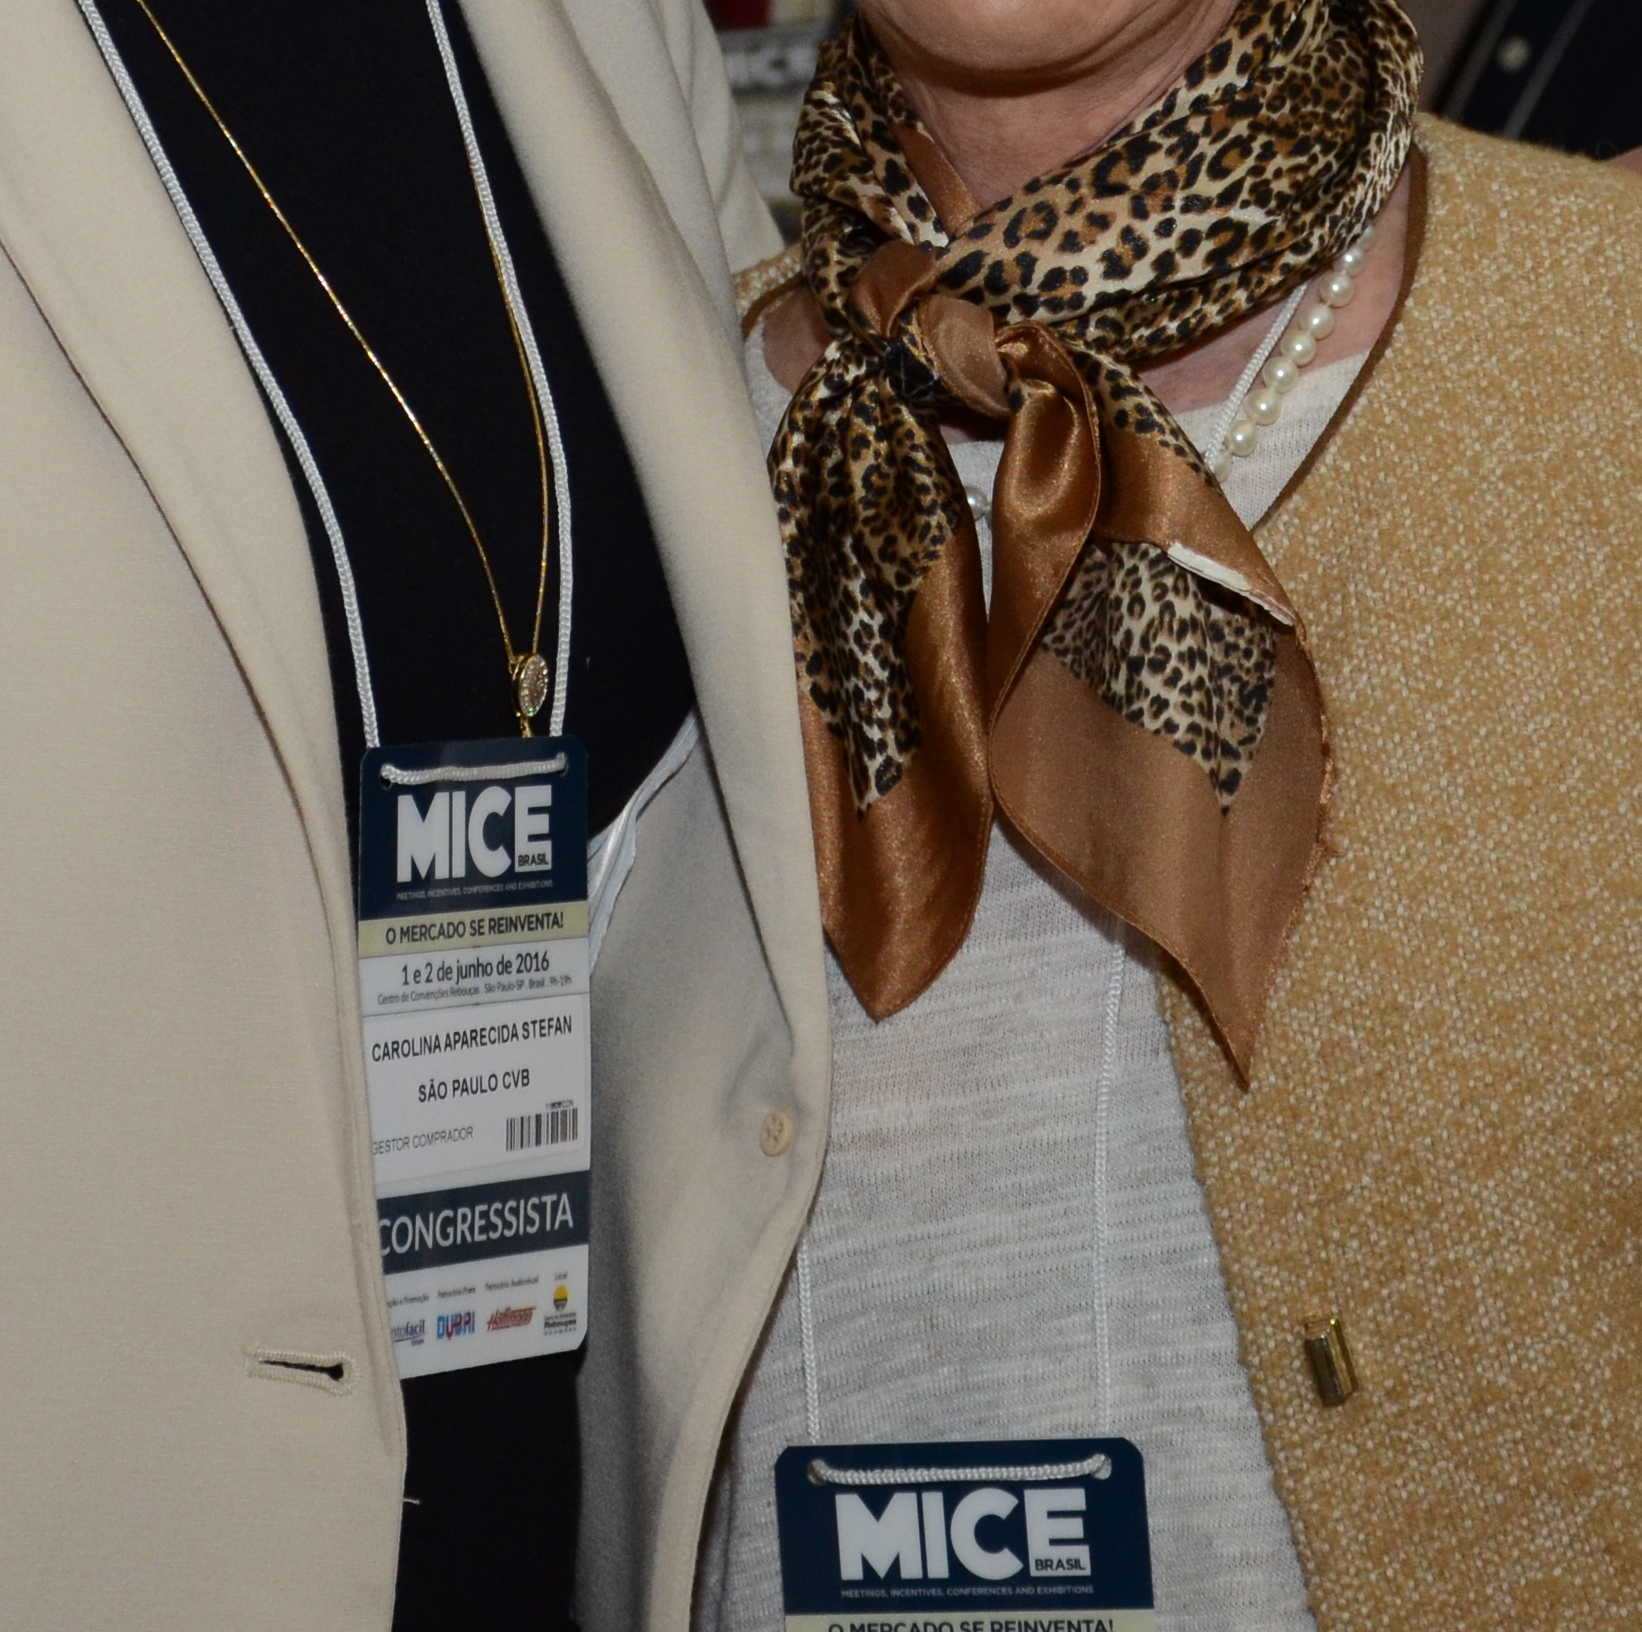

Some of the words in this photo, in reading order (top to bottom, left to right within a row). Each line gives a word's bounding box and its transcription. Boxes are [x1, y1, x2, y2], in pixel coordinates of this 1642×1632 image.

[396, 784, 553, 883] MICE
[518, 853, 549, 867] BRASIL
[505, 881, 517, 891] AND
[385, 927, 396, 945] O
[399, 921, 466, 944] MERCADO
[469, 918, 486, 937] SE
[488, 911, 564, 935] REINVENTA!
[401, 965, 410, 986] 1
[413, 969, 422, 984] e
[424, 962, 433, 984] 2
[436, 960, 453, 982] de
[455, 956, 493, 985] junho
[496, 954, 513, 976] de
[515, 950, 550, 974] 2016
[377, 991, 400, 1005] Centro
[401, 991, 410, 1002] de
[410, 986, 449, 1002] Convenções
[449, 983, 480, 997] Rebouças
[484, 982, 497, 993] São
[372, 1035, 442, 1062] CAROLINA
[443, 1022, 519, 1052] APARECIDA
[521, 1015, 573, 1040] STEFAN
[418, 1079, 448, 1103] SÃO
[452, 1072, 499, 1099] PAULO
[502, 1068, 531, 1091] CVB
[372, 1137, 410, 1155] GESTOR
[412, 1126, 474, 1149] COMPRADOR
[835, 1487, 1092, 1581] MICE
[1035, 1558, 1086, 1571] BRASIL
[841, 1589, 889, 1600] MEETINGS,
[890, 1588, 945, 1598] INCENTIVES,
[946, 1586, 1013, 1597] CONFERENCES
[1014, 1586, 1035, 1595] AND
[1036, 1584, 1095, 1595] EXHIBITIONS
